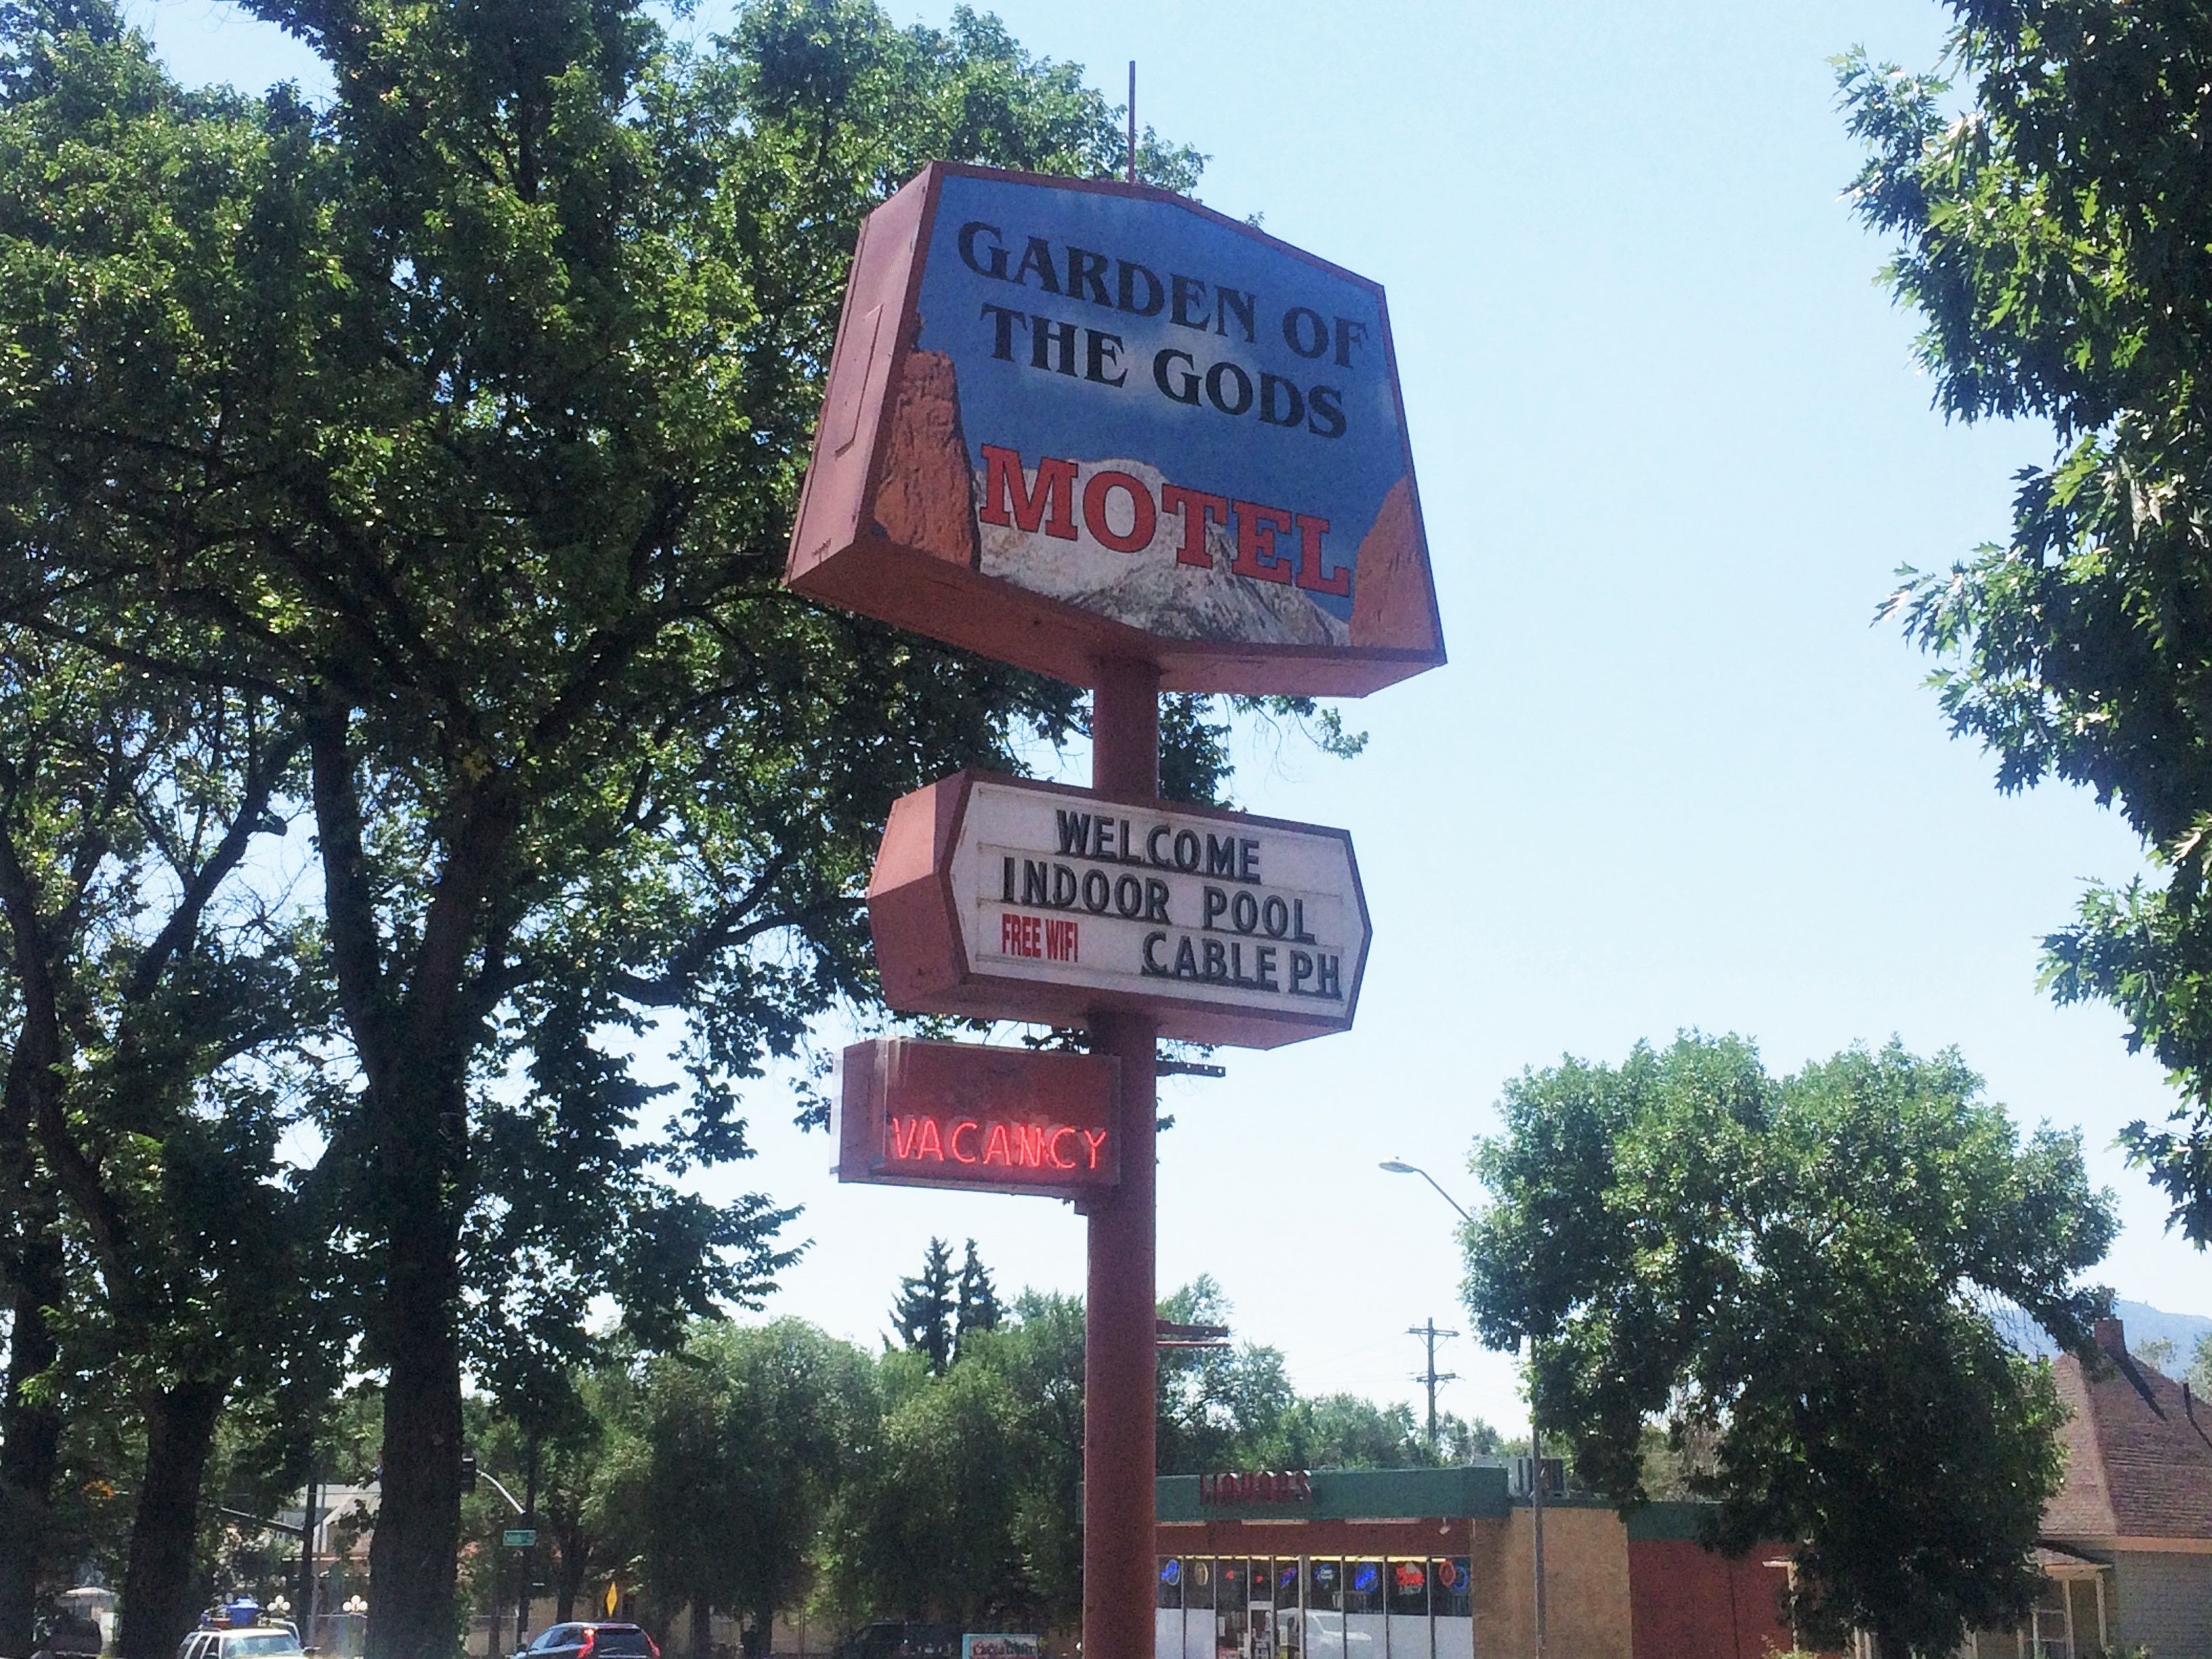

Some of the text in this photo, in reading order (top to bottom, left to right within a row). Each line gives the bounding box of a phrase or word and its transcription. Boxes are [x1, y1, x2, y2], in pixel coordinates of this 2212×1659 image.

[958, 222, 1368, 369] GARDEN OF
[980, 302, 1347, 438] THE GODS
[980, 443, 1351, 597] MOTEL
[1055, 809, 1261, 884] WELCOME
[1001, 857, 1316, 944] INDOOR POOL
[1002, 913, 1078, 963] FREE WIFI
[1141, 930, 1343, 1000] CABLE PH
[893, 1117, 1107, 1170] VACANCY
